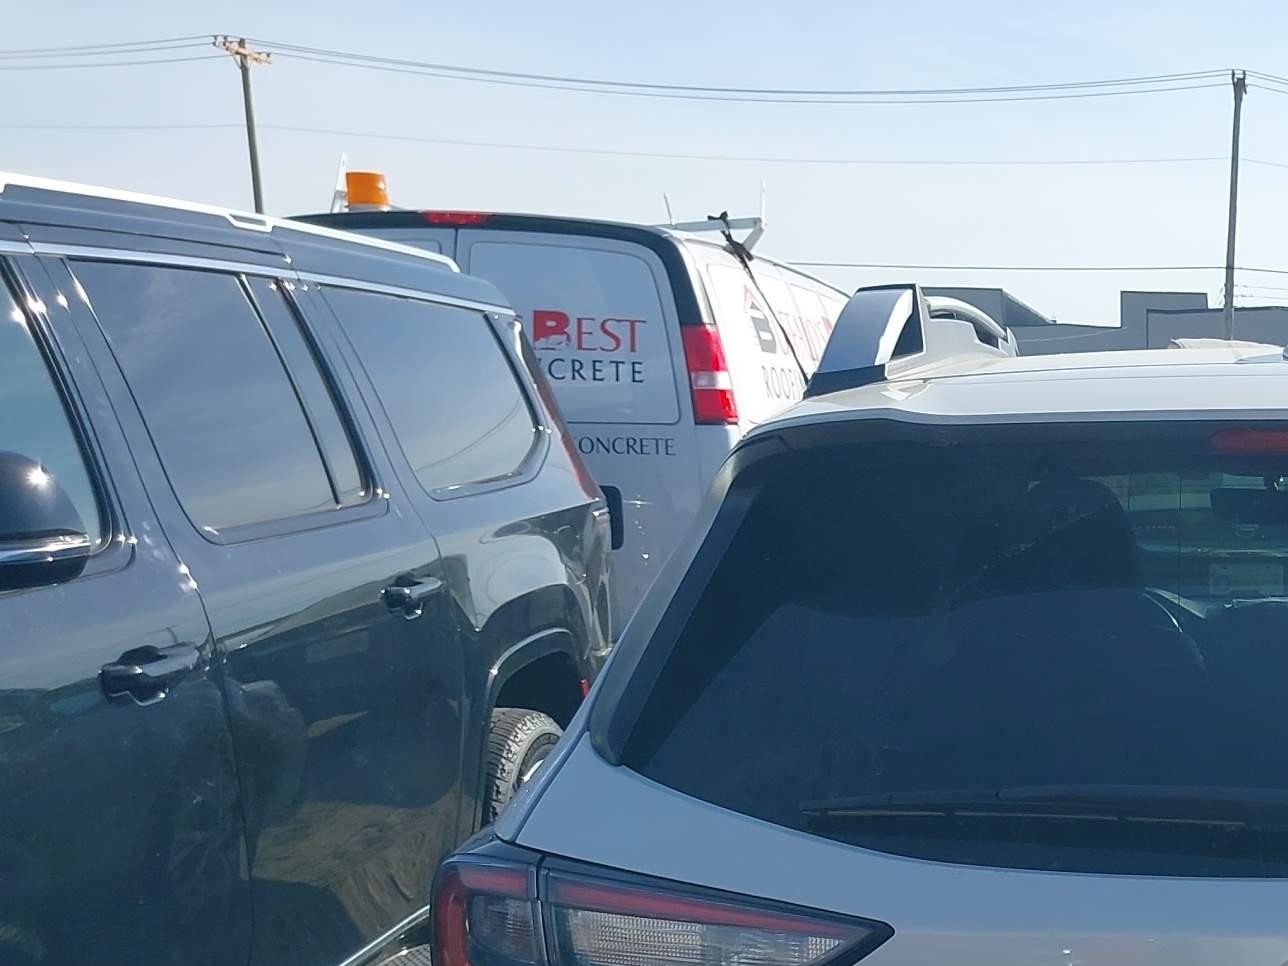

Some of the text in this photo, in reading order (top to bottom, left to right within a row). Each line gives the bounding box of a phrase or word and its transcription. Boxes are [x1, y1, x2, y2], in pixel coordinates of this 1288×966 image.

[533, 310, 647, 353] BEST
[538, 357, 645, 383] CRETE
[573, 436, 677, 455] ONCRETE
